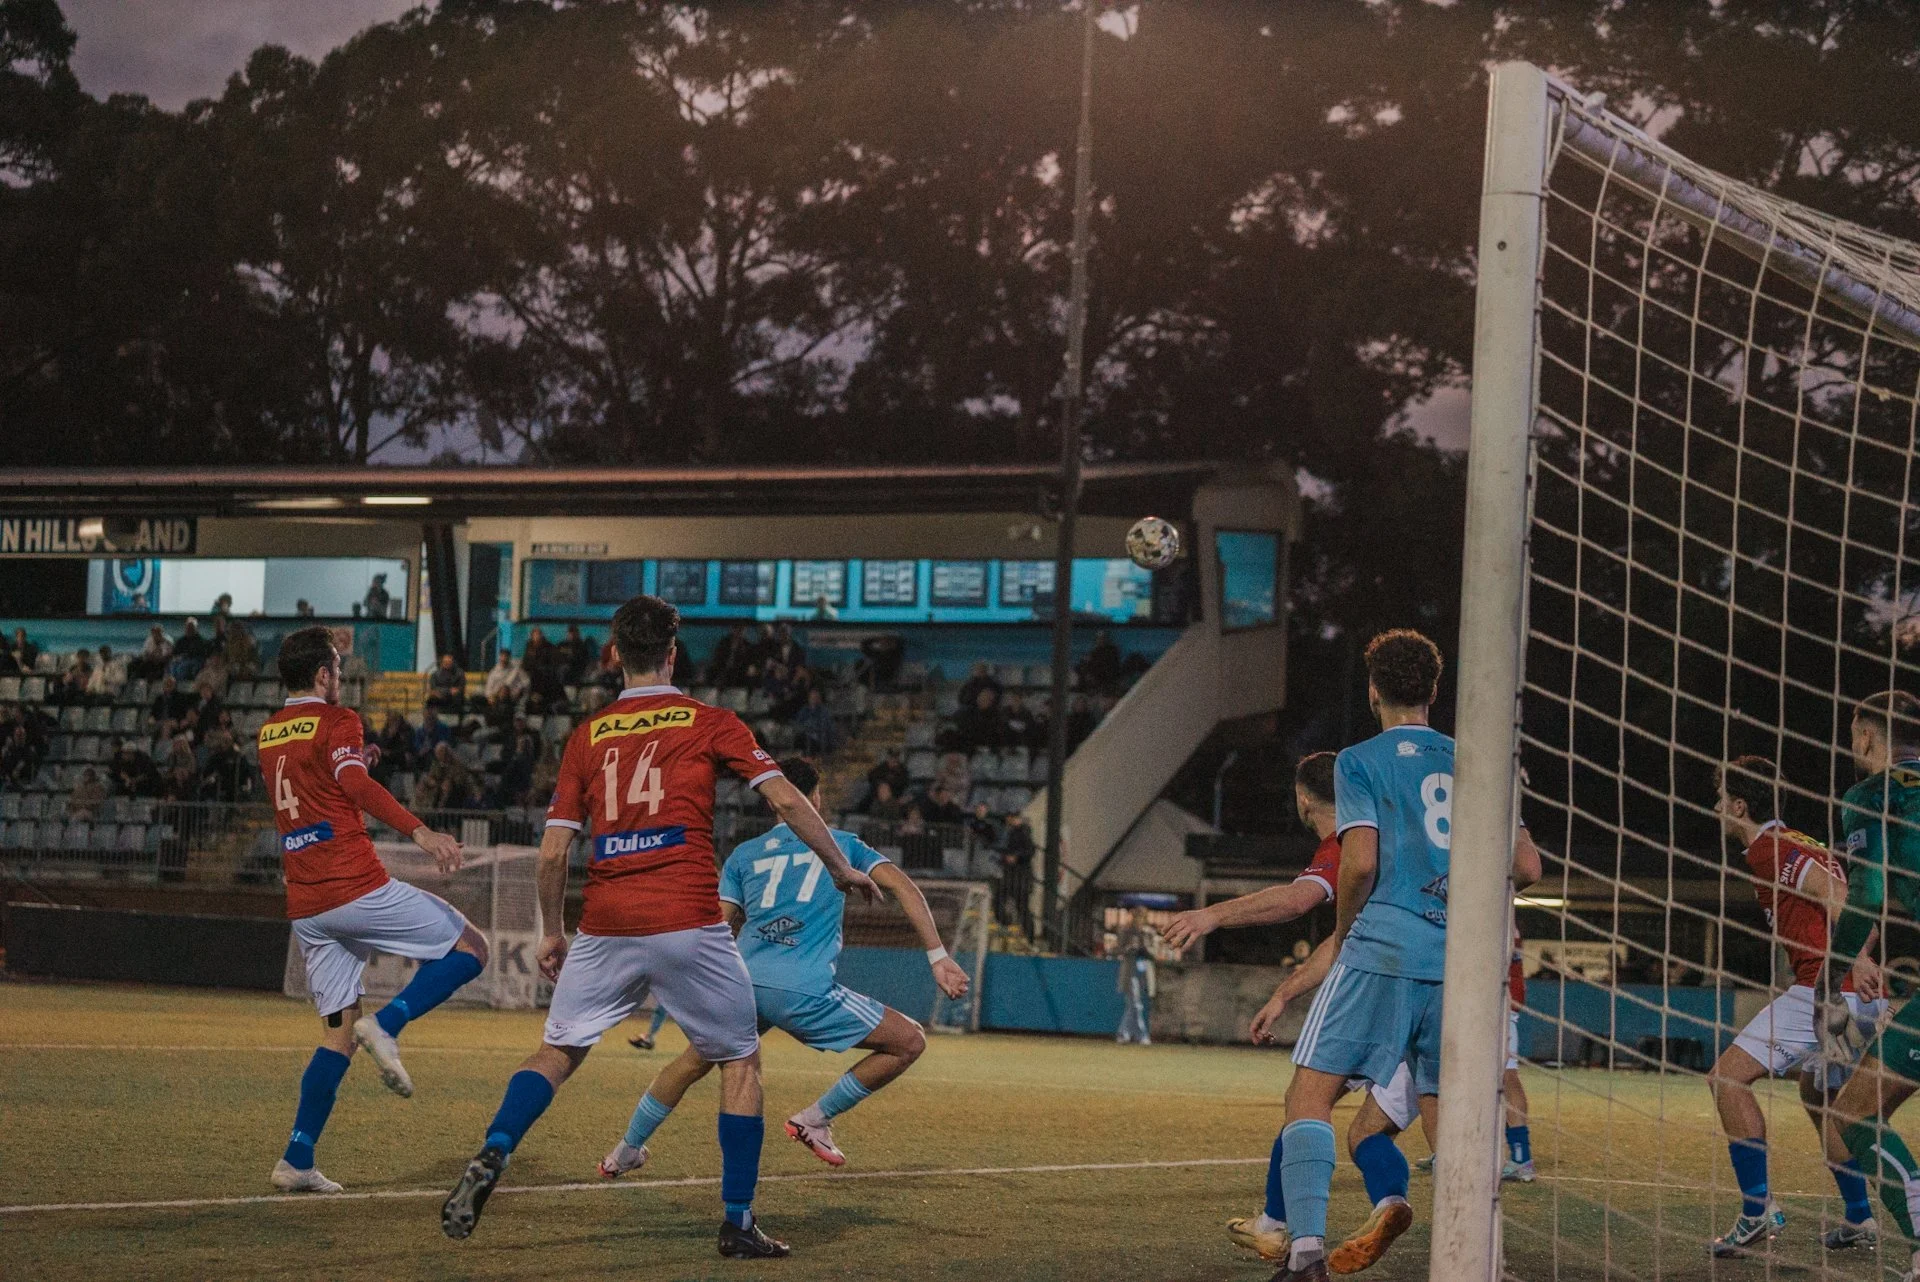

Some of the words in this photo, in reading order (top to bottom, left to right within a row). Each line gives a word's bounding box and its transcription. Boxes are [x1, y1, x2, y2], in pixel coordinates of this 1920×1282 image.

[260, 721, 315, 743] ALAND
[594, 710, 692, 739] ALAND
[275, 754, 300, 821] 4
[602, 740, 665, 822] 14
[1420, 772, 1454, 850] 8
[604, 831, 666, 855] Dulux
[753, 850, 825, 909] 77
